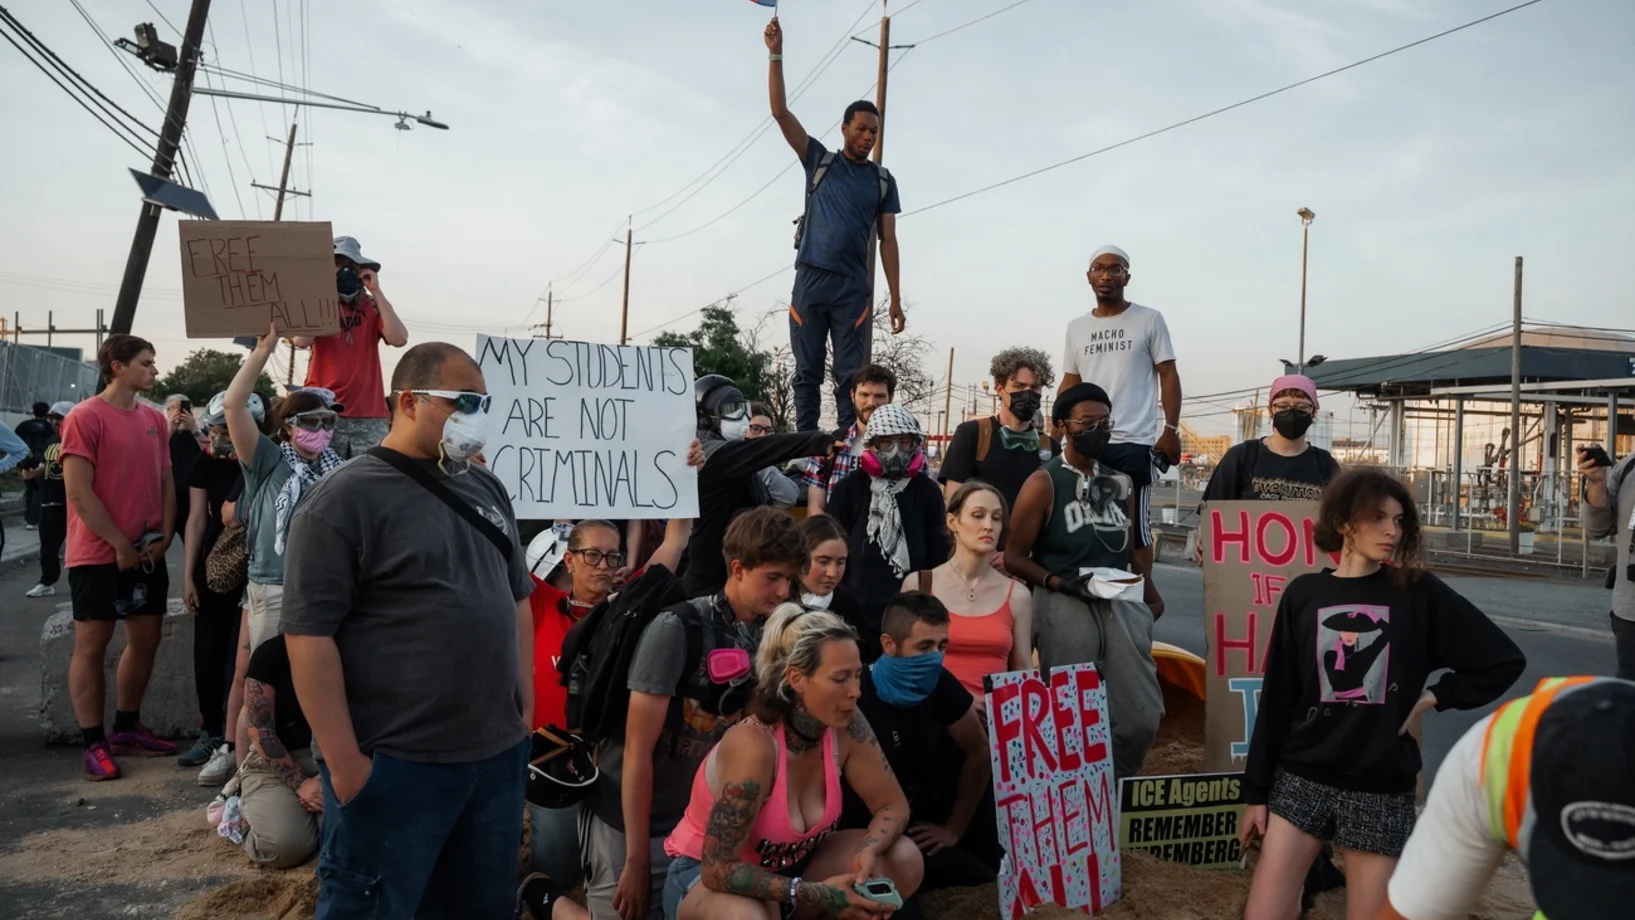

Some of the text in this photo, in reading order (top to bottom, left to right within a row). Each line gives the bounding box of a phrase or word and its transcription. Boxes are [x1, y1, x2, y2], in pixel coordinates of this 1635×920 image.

[187, 236, 262, 277] FREE
[214, 272, 282, 305] THEM
[1084, 340, 1133, 356] FEMINIST
[1091, 328, 1125, 342] MACHO
[479, 337, 689, 395] MY STUDENTS
[502, 397, 635, 441] ARE NOT
[992, 669, 1108, 783] FREE
[1131, 777, 1241, 807] ICE Agents
[997, 772, 1115, 876] THEM
[1128, 811, 1238, 843] REMEMBER
